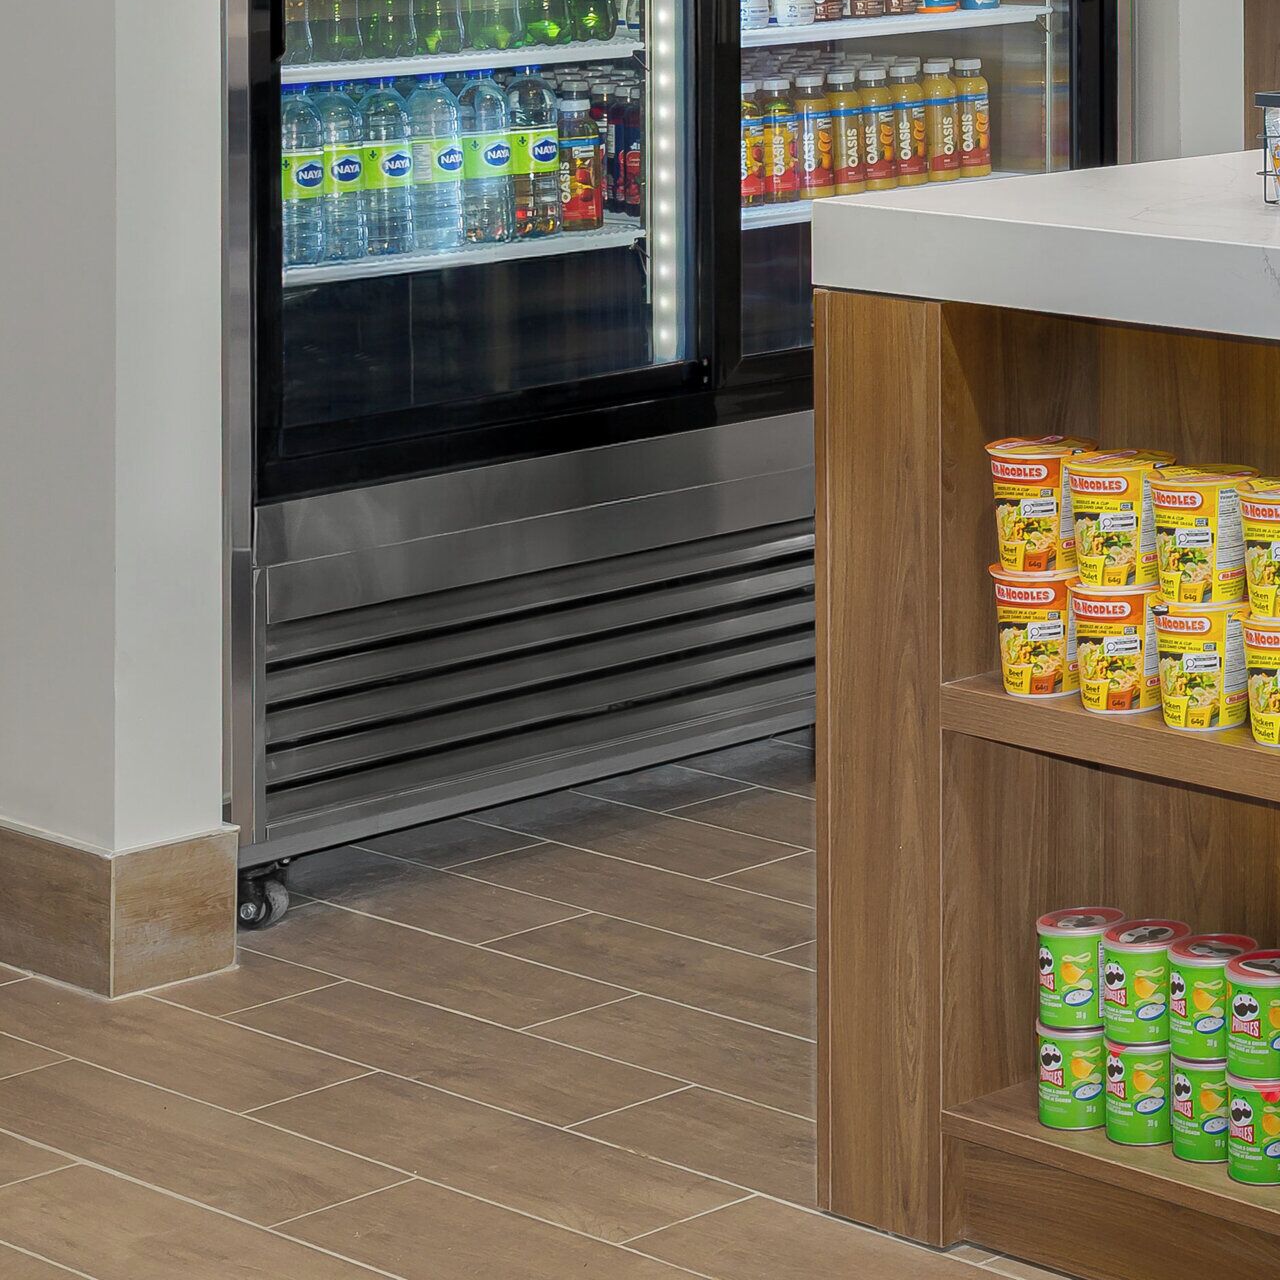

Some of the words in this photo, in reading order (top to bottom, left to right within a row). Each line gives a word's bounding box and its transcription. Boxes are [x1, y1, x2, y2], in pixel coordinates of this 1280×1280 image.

[943, 116, 954, 155] OASIS
[962, 113, 974, 152] OASIS
[866, 125, 877, 164] OASIS
[900, 121, 912, 161] OASIS
[488, 148, 510, 160] NAYA
[535, 144, 557, 155] NAYA
[847, 128, 858, 168] OASIS
[772, 135, 785, 176] OASIS
[335, 163, 362, 174] NAYA
[384, 159, 411, 170] NAYA
[298, 169, 323, 180] NAYA
[561, 162, 571, 203] OASIS
[1001, 464, 1043, 478] NOODLES
[1079, 477, 1122, 490] NOODLES
[1156, 491, 1197, 506] NOODLES
[1003, 545, 1018, 554] Beef
[1107, 576, 1122, 586] 64g
[1005, 588, 1050, 601] NOODLES
[1183, 593, 1197, 601] 64g
[1082, 602, 1126, 615] NOODLES
[1162, 616, 1205, 630] NOODLES
[1009, 668, 1023, 677] Beef
[1085, 684, 1100, 693] Beef
[1191, 717, 1204, 726] 64g
